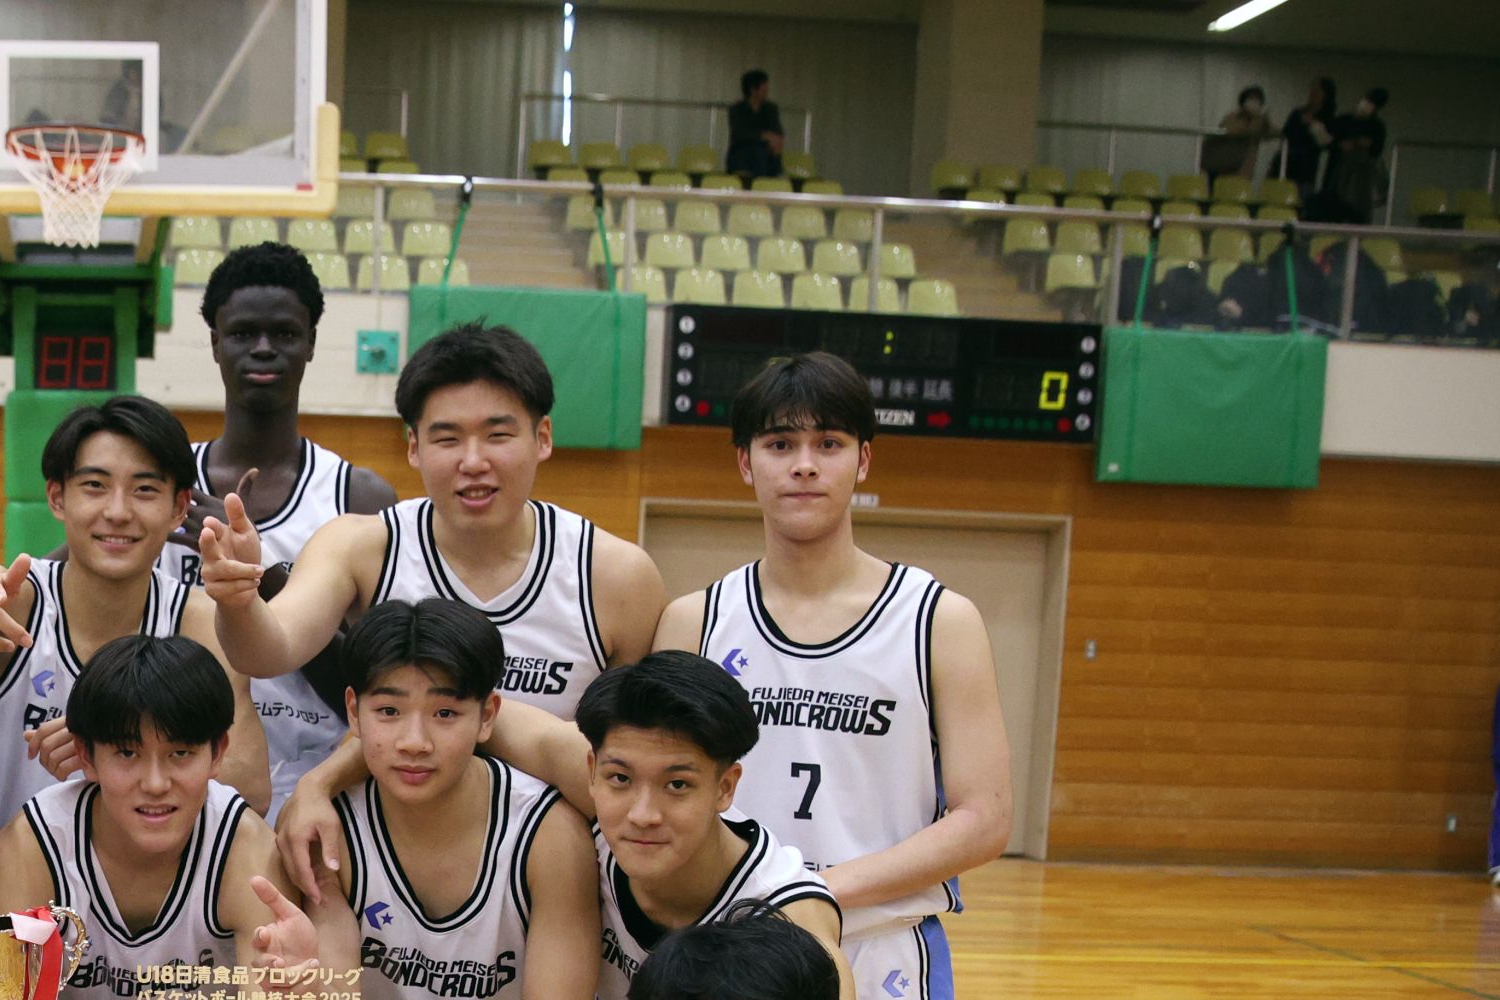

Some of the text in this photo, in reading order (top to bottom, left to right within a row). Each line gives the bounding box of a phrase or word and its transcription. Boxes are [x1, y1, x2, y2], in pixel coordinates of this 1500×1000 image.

[1038, 371, 1070, 411] 0
[751, 687, 869, 709] FUJIEDA MEISEI
[750, 699, 897, 737] ONDCROWS
[790, 761, 822, 821] 7
[136, 965, 364, 986] U18日清食品ブロックリーグ
[361, 936, 517, 999] BONDCROWS
[388, 946, 497, 977] FUJIEDA MEISE
